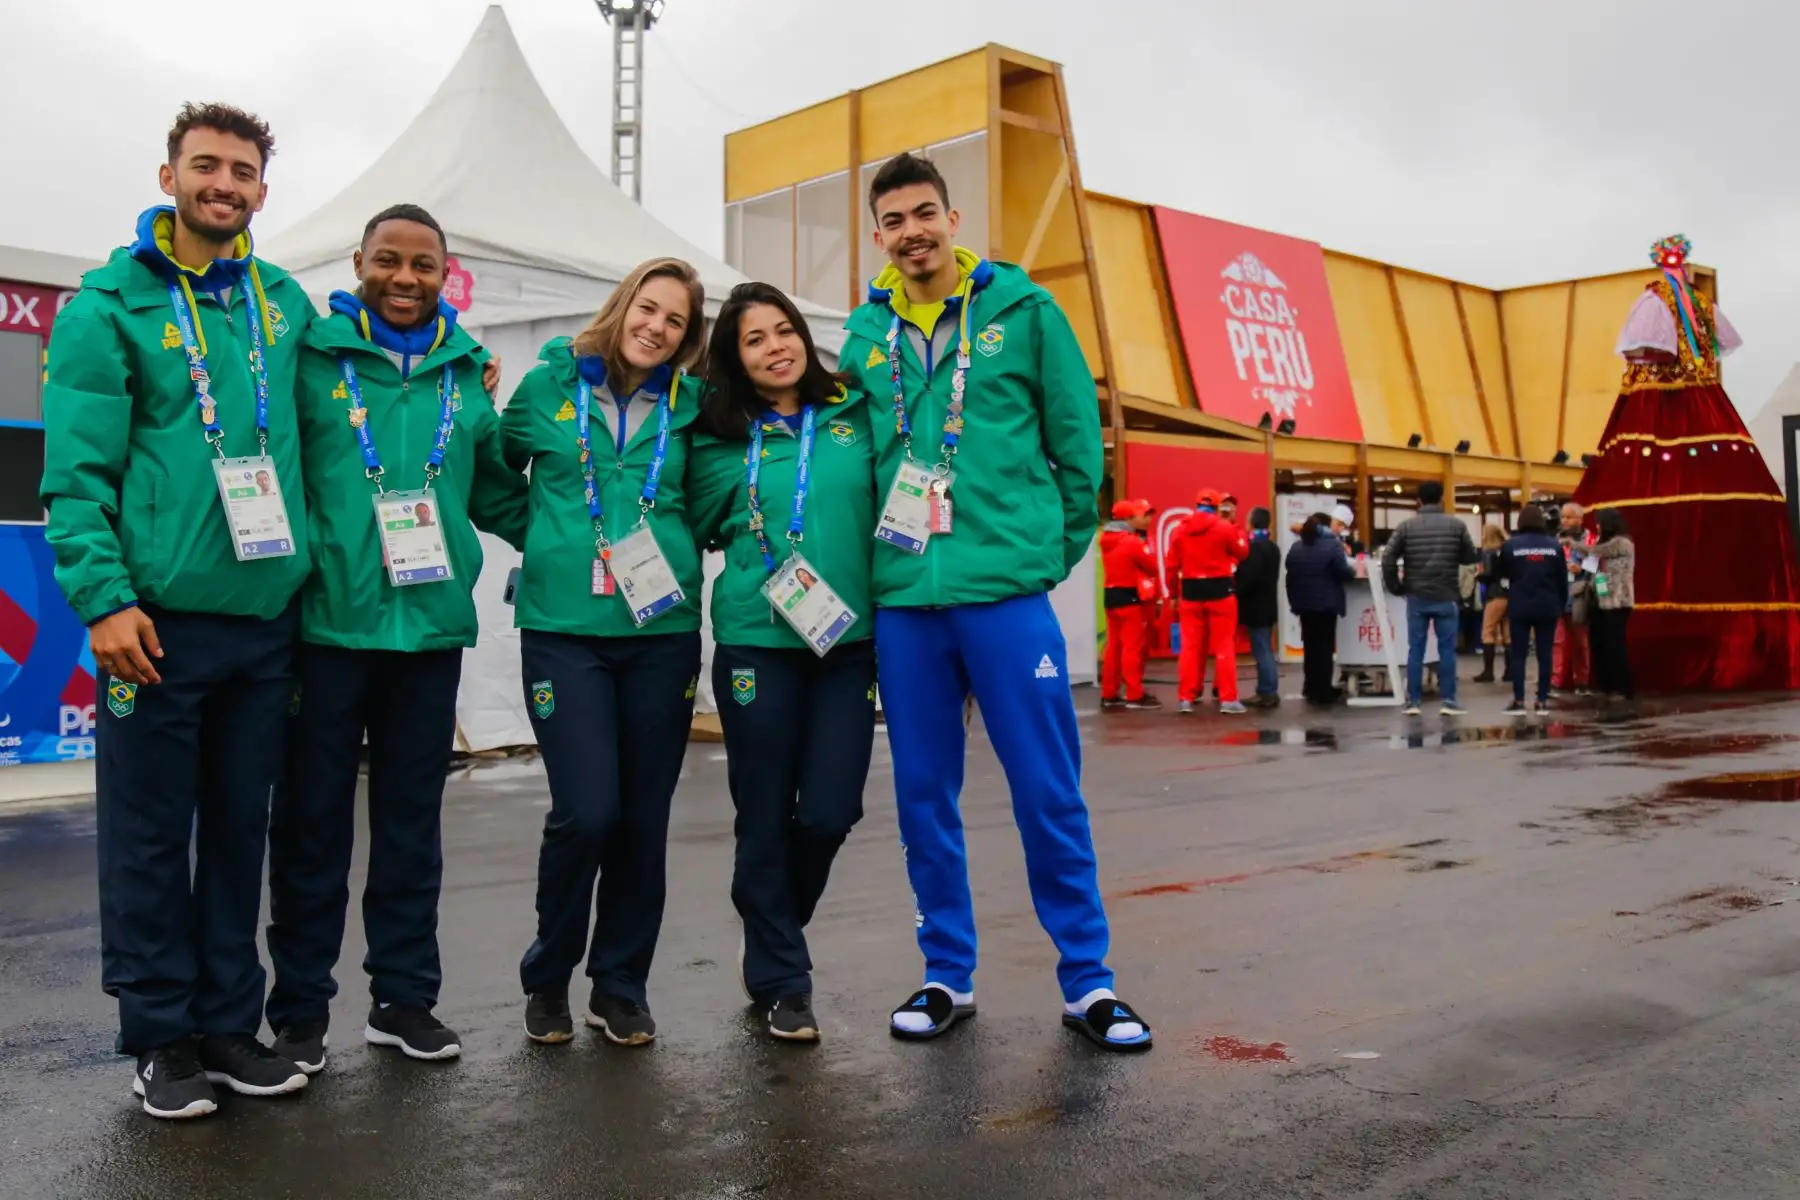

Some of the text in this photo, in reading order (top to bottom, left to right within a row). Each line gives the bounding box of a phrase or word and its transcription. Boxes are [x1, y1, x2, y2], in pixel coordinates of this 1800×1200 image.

[1224, 284, 1295, 326] CASA
[280, 541, 288, 550] R
[912, 542, 920, 551] R
[436, 568, 445, 577] R
[671, 593, 680, 602] R
